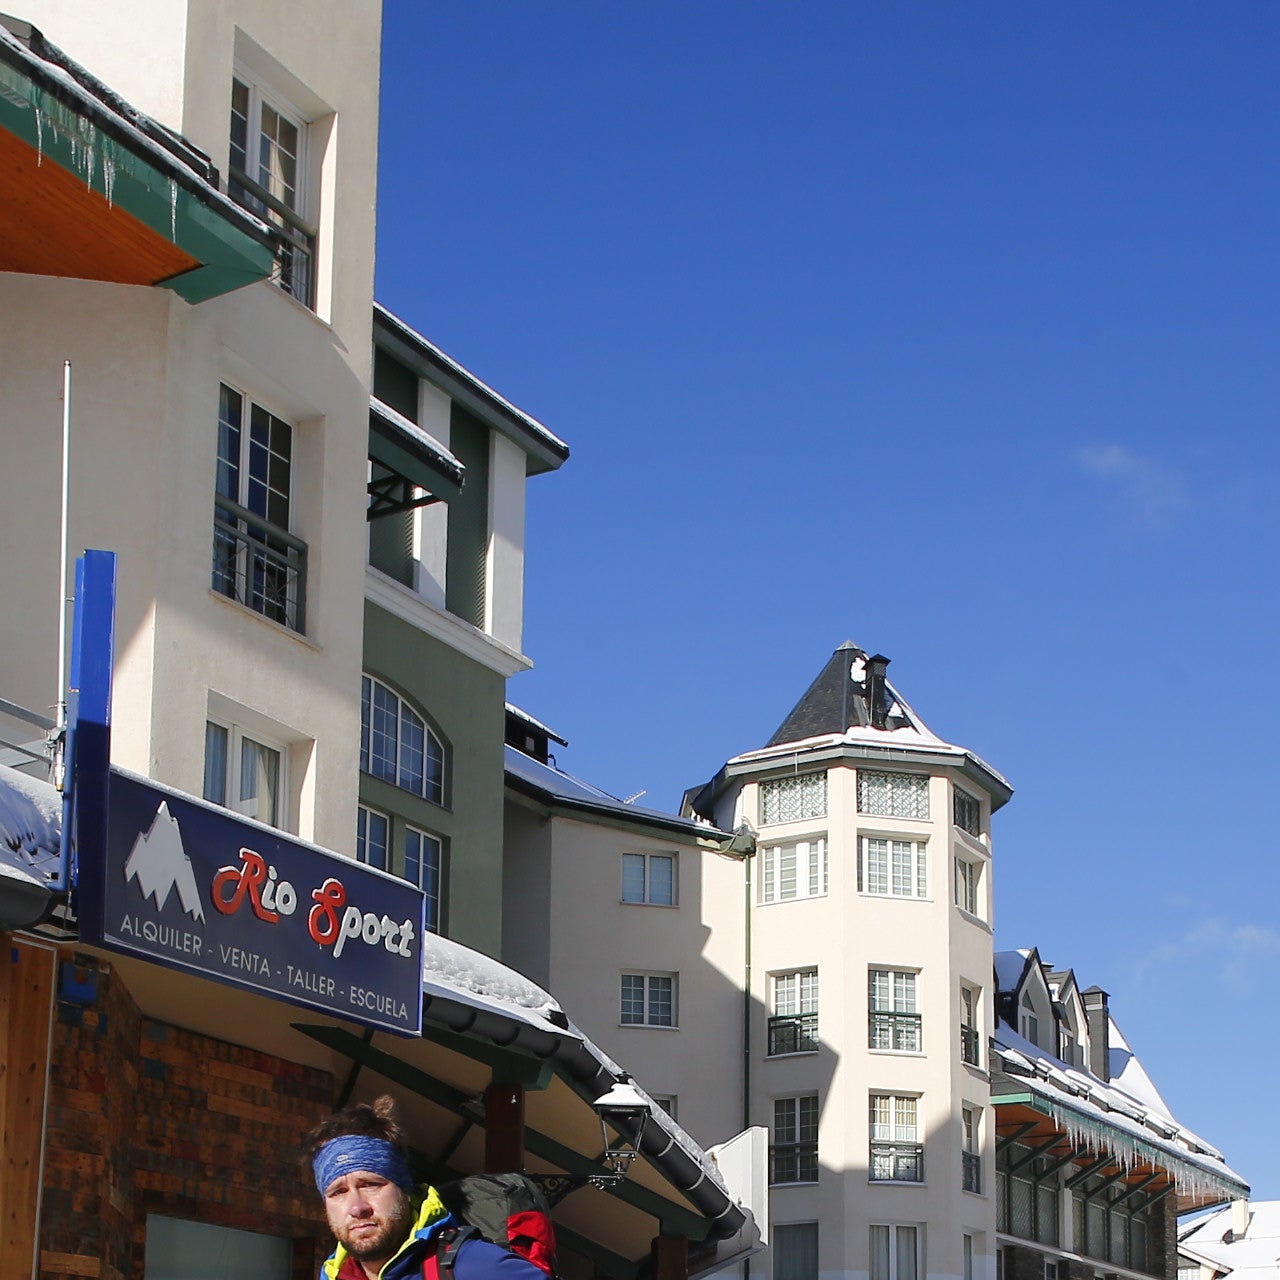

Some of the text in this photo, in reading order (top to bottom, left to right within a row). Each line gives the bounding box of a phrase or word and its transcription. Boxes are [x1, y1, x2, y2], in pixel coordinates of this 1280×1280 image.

[211, 847, 416, 959] Rio Sport
[120, 914, 202, 956] ALQUILER
[220, 943, 271, 978] VENTA
[287, 965, 336, 998] TALLER
[350, 985, 409, 1020] ESCUELA
